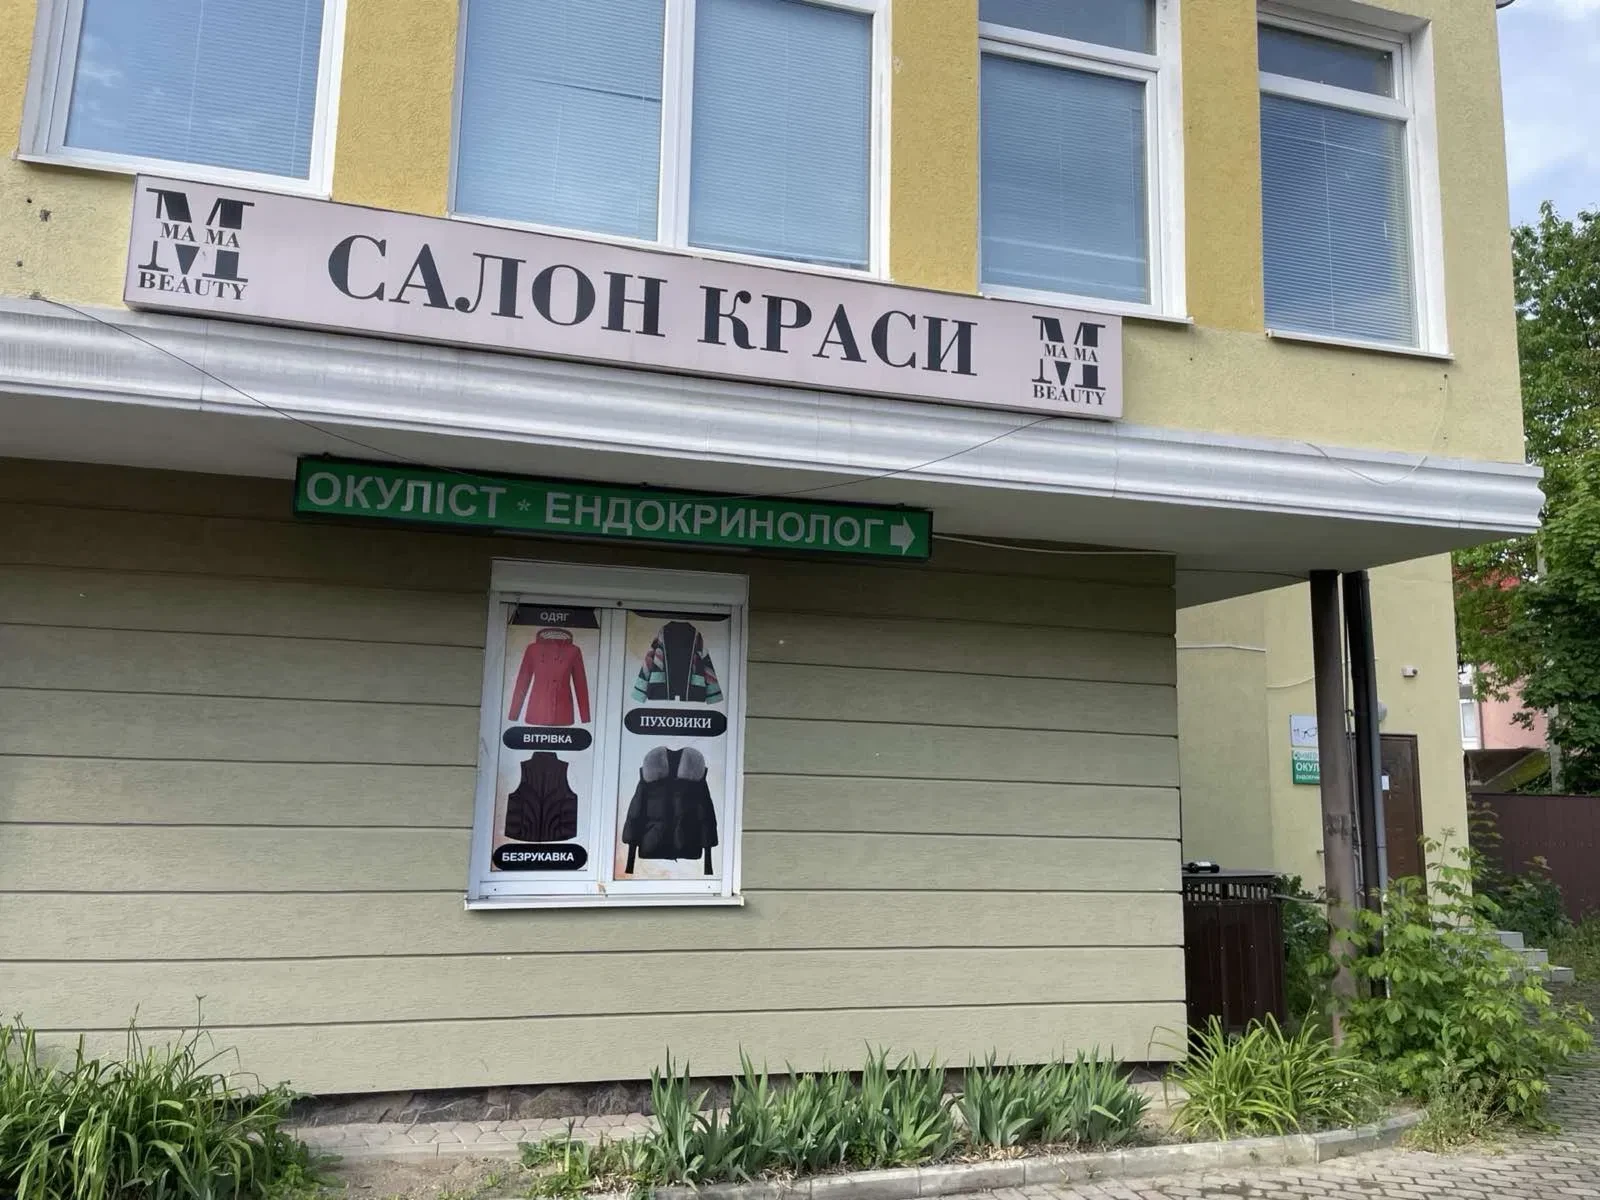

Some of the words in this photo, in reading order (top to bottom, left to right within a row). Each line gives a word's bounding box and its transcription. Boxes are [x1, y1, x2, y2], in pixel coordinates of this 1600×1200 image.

[138, 271, 248, 300] BEAUTY
[328, 234, 668, 338] САЛОН
[697, 285, 978, 377] КРАСИ
[1032, 384, 1106, 405] BEAUTY
[305, 471, 508, 519] ОКУЛІСТ
[544, 491, 885, 548] ЕНДОКРИНОЛОГ
[539, 611, 570, 623] ОДЯГ
[639, 715, 712, 729] ПУХОВИКИ
[522, 733, 573, 744] ВІТРІВКА
[501, 850, 575, 862] БЕЗРУКАВКА
